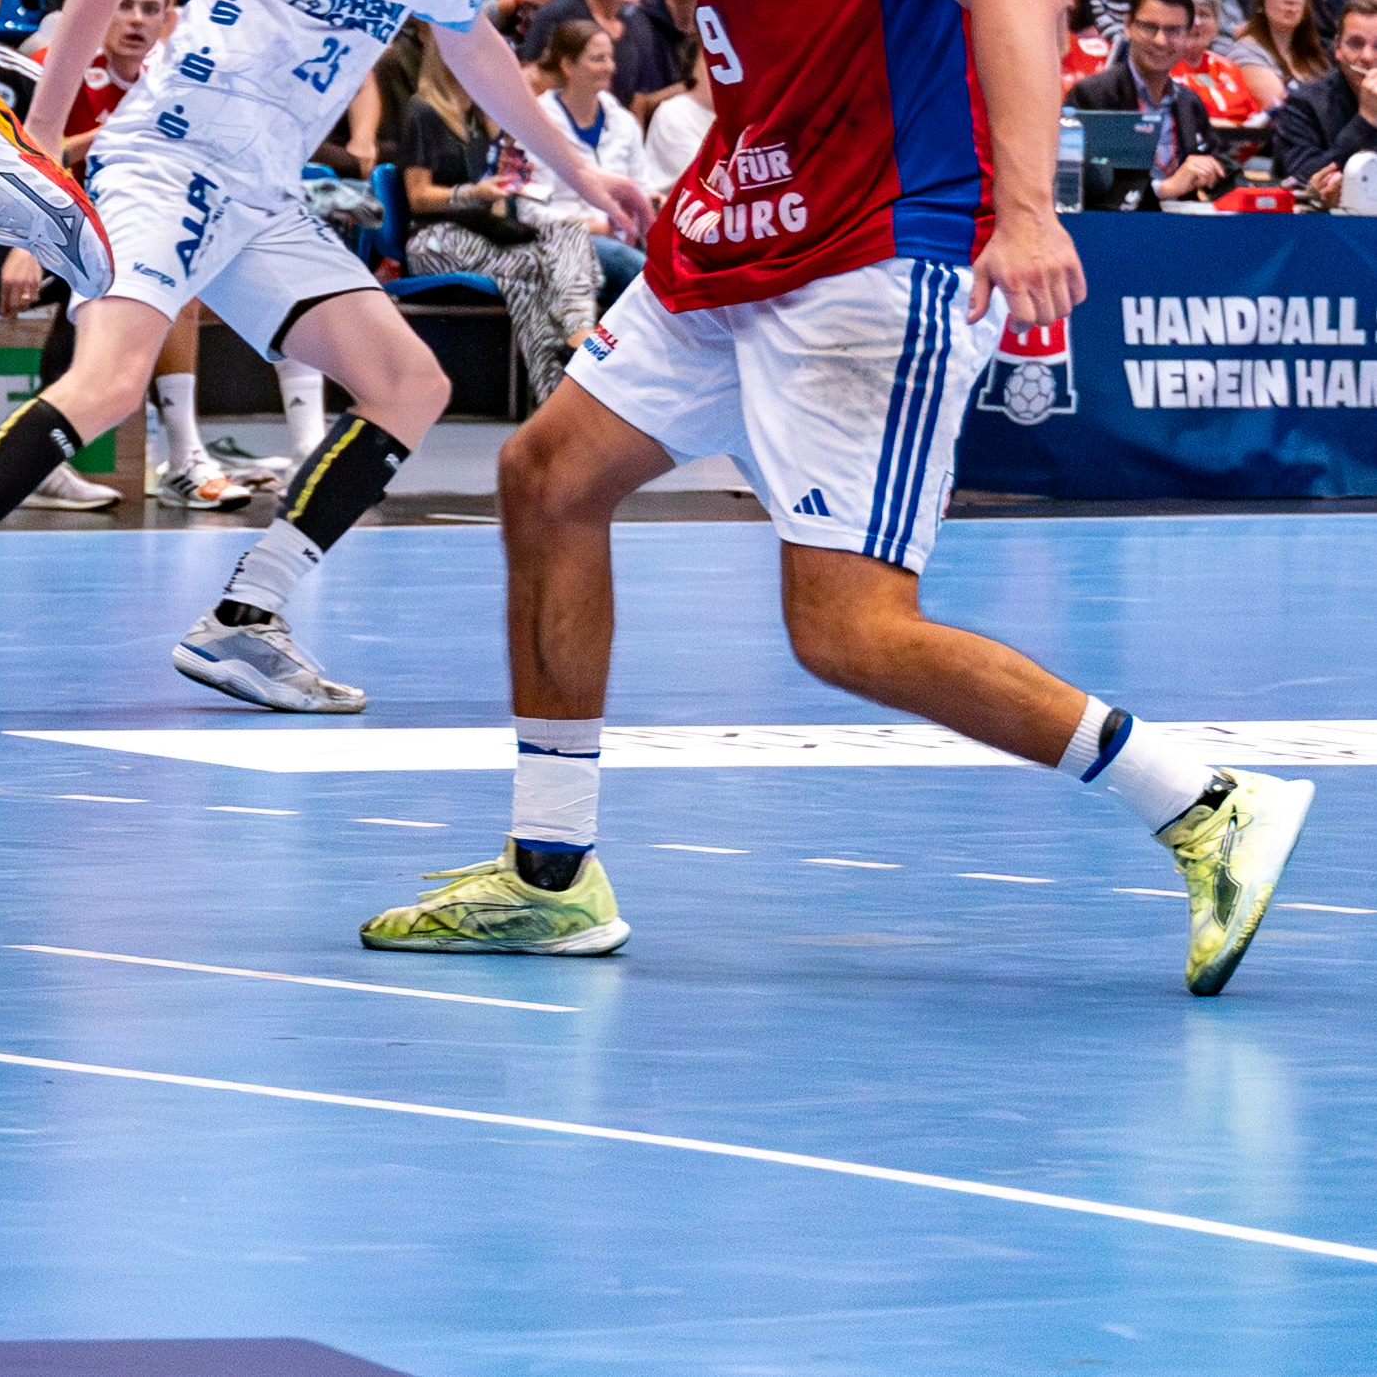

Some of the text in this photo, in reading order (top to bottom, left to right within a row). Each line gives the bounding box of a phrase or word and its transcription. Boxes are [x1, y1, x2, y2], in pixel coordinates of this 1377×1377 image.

[292, 37, 350, 94] 25
[696, 5, 744, 86] 9
[736, 146, 793, 184] FÜR
[1122, 295, 1367, 346] HANDBALL
[1123, 358, 1290, 409] VEREIN
